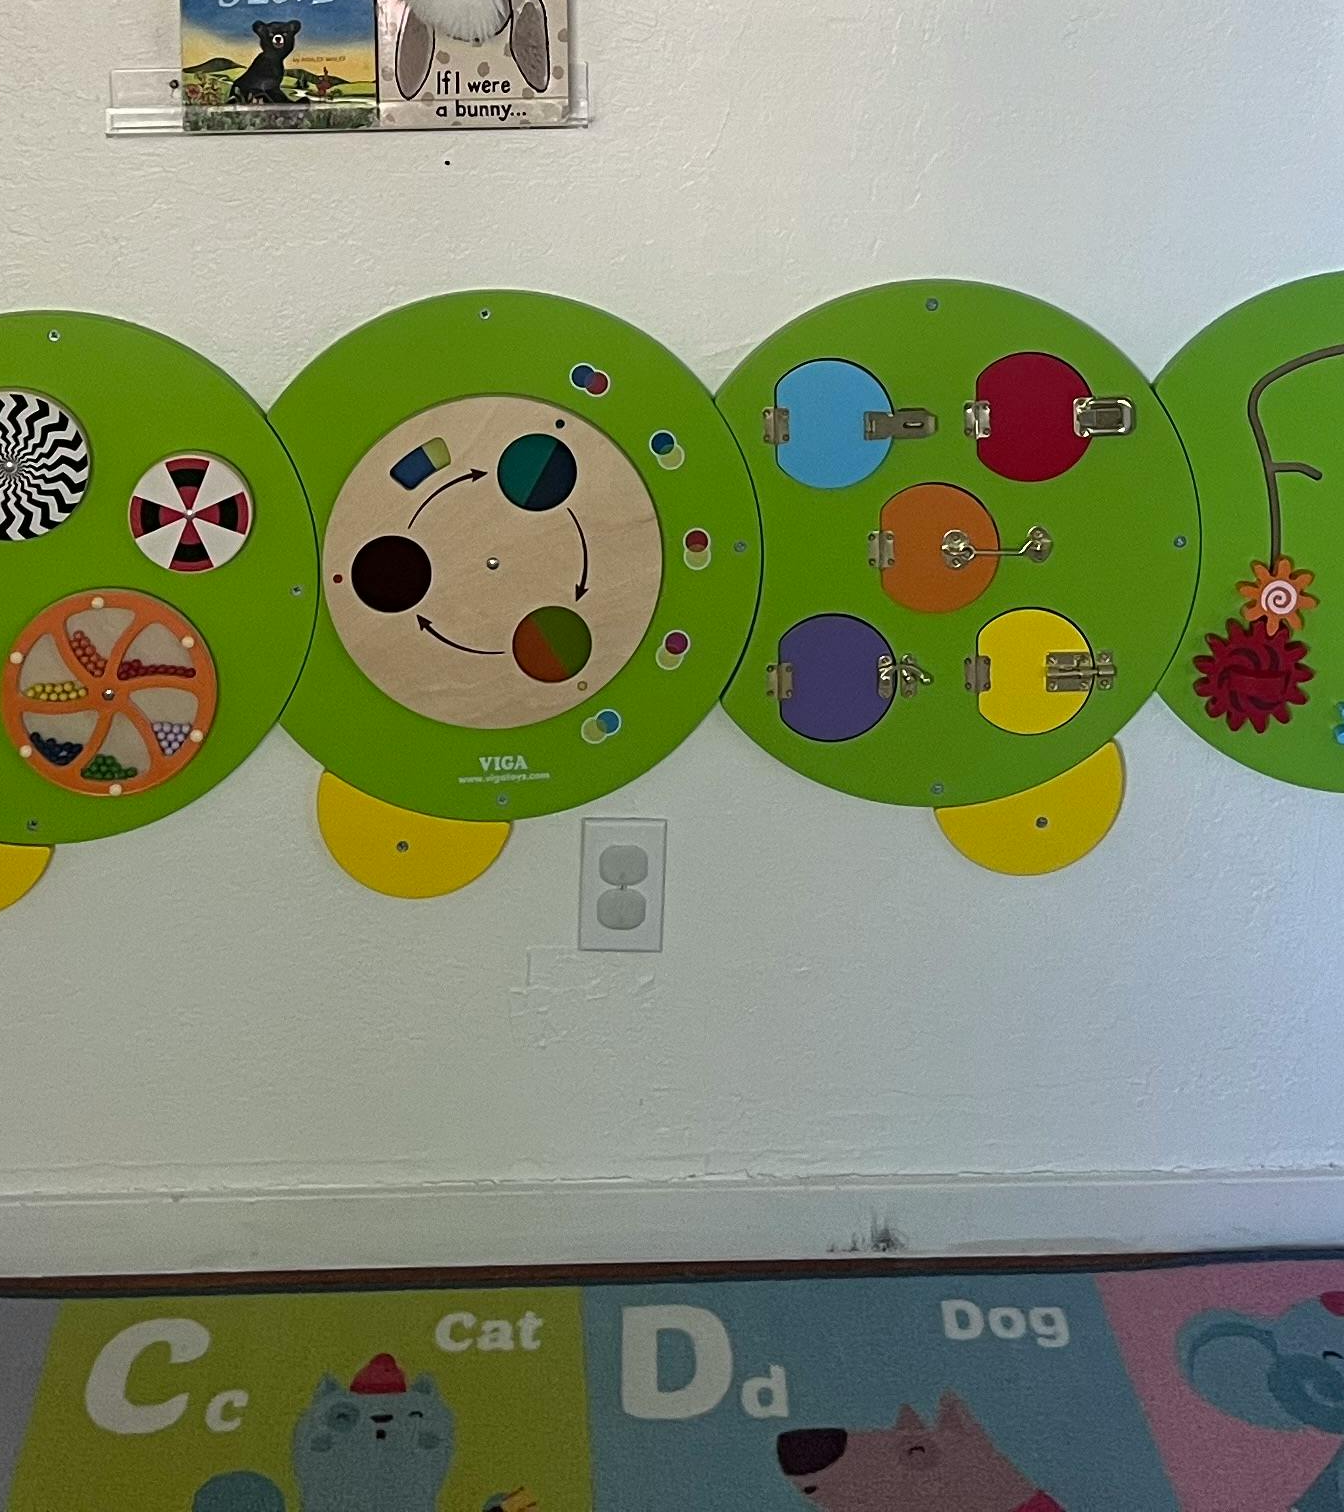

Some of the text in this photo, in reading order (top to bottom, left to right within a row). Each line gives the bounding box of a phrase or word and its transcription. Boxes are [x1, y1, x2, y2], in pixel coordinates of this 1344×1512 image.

[436, 70, 511, 95] If I were
[436, 99, 527, 122] a bunny...
[479, 755, 528, 771] VIGA
[458, 772, 551, 784] www.vigatoys.com
[434, 1311, 543, 1352] Cat
[940, 1298, 1071, 1348] Dog
